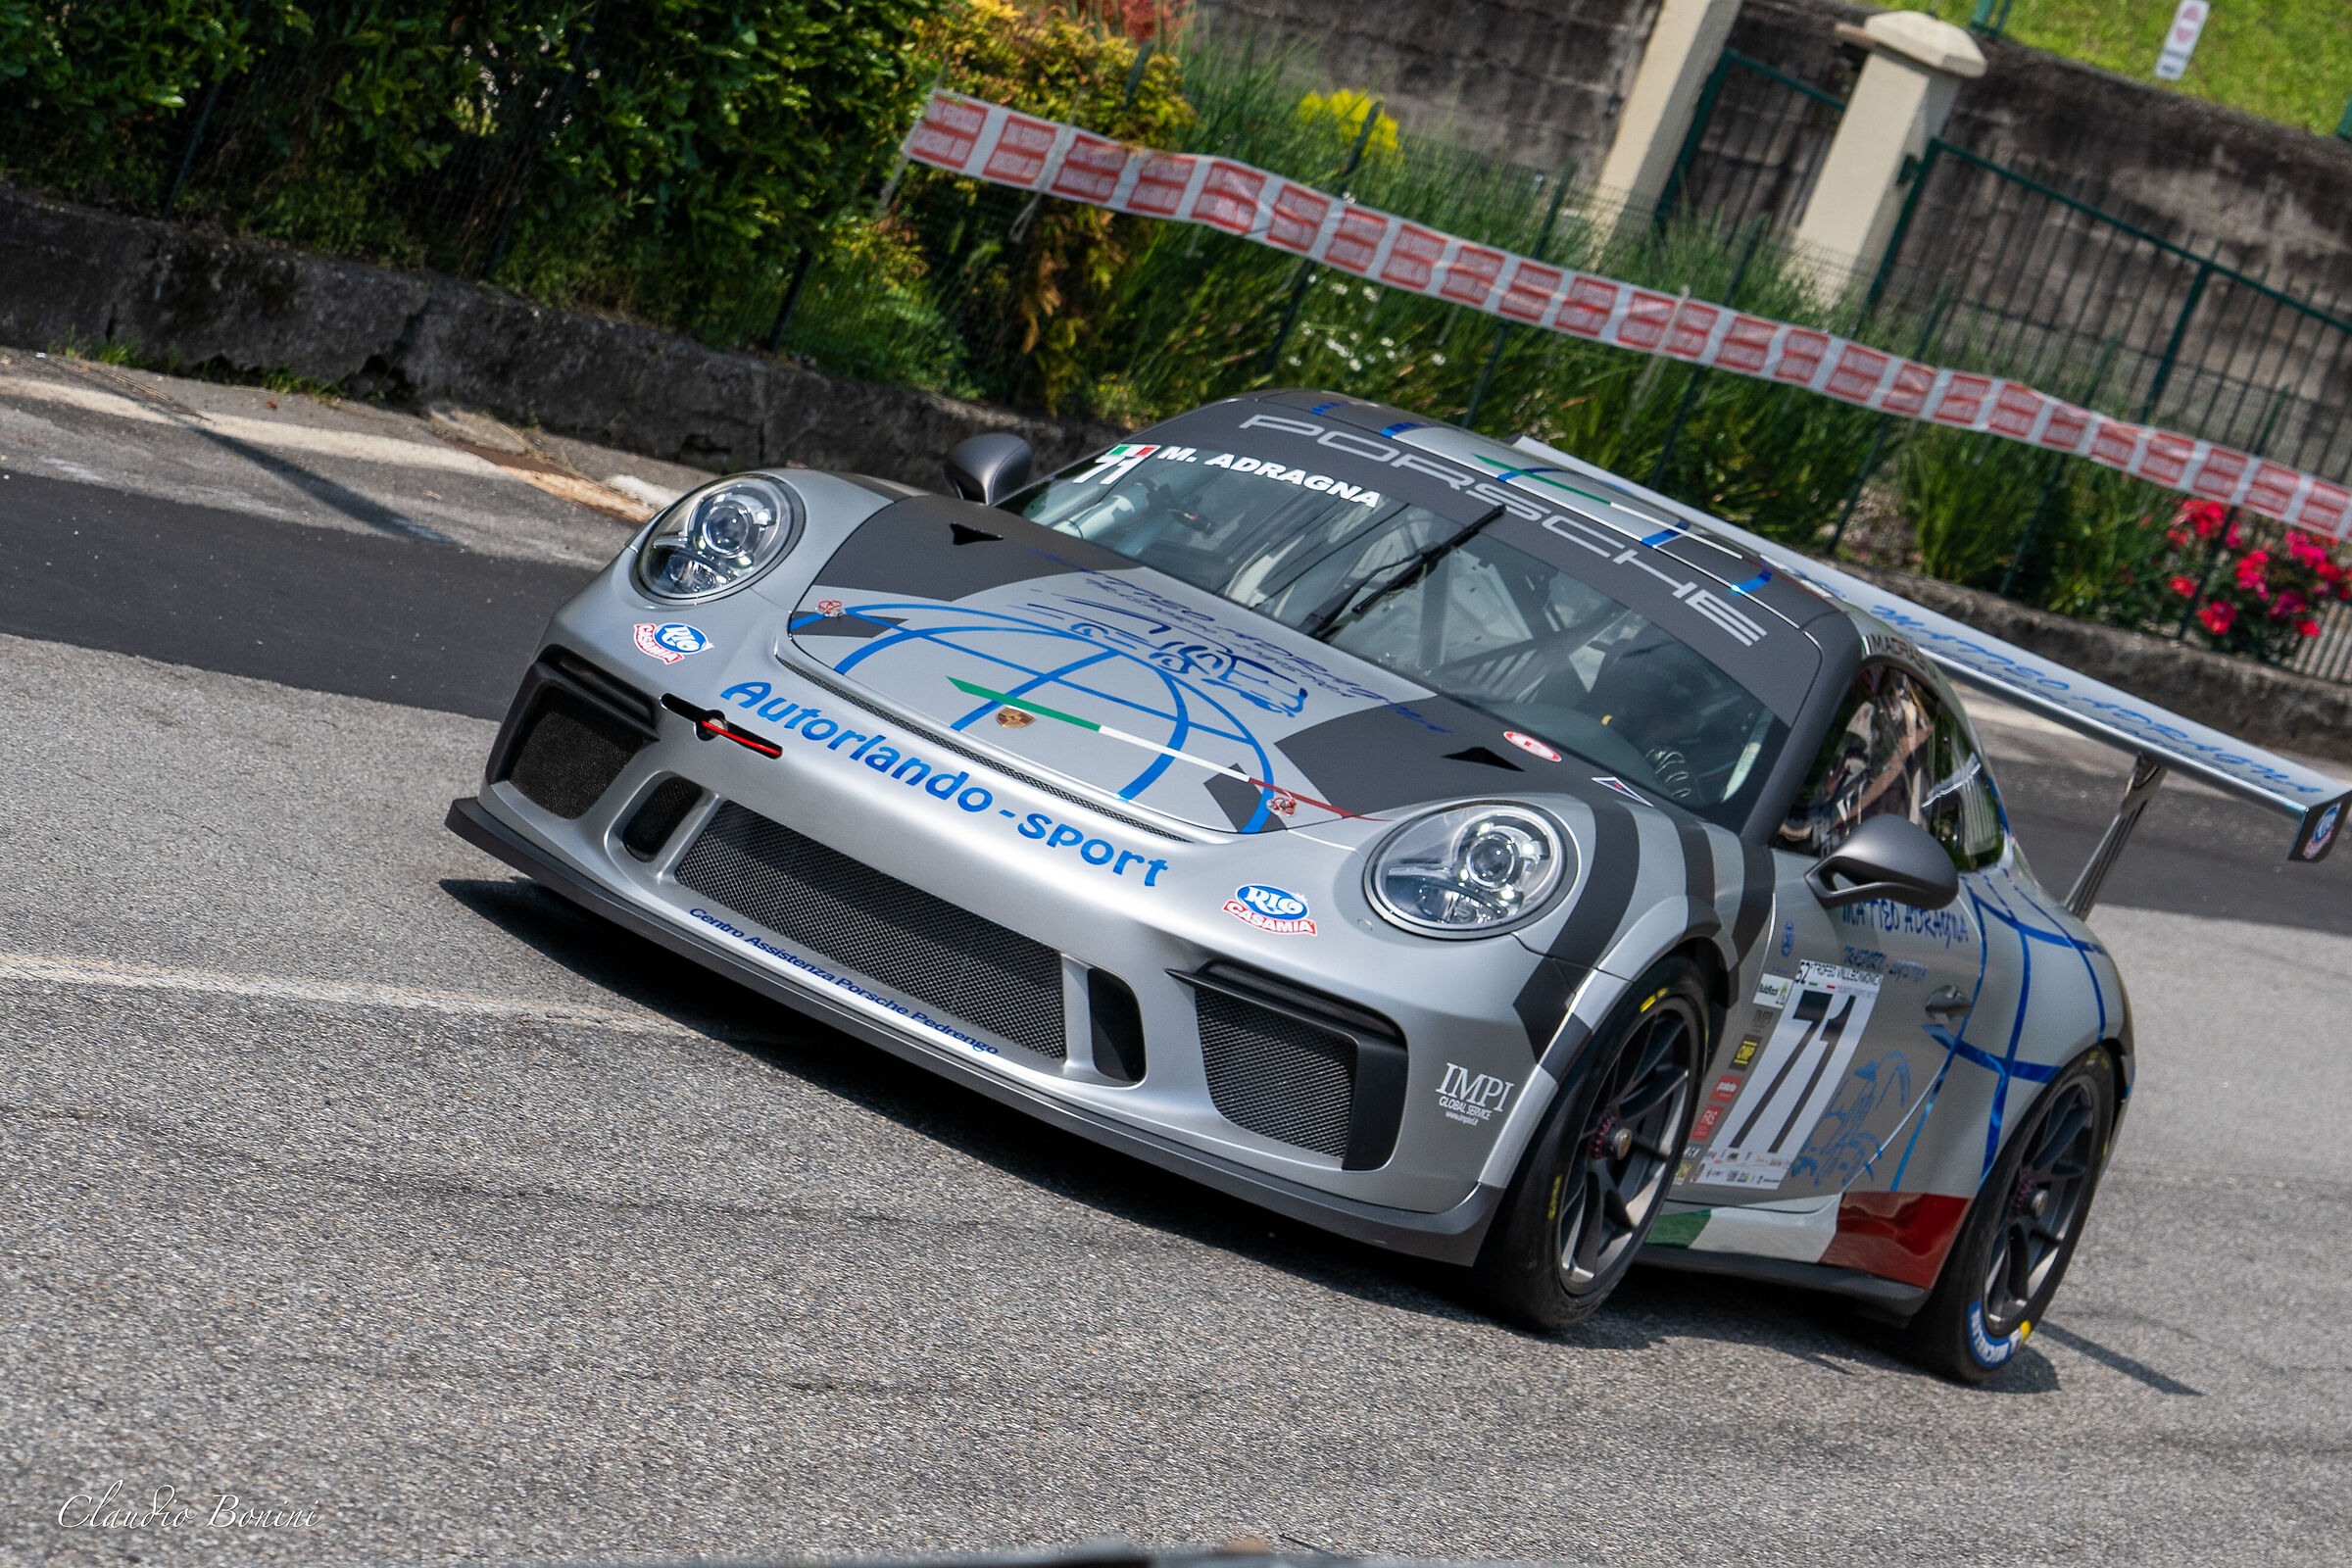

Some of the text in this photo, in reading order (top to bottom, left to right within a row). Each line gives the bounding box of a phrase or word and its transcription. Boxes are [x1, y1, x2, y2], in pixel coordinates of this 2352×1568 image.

[1073, 456, 1138, 485] 71
[1157, 446, 1383, 509] M. ADRAGNA
[1239, 413, 1768, 647] PORSCHE
[1226, 902, 1315, 933] CASAMIA
[1244, 886, 1304, 915] RIO
[689, 906, 1000, 1054] Centro Assistenza Porsche Pedrengo
[1435, 1061, 1515, 1113] IMPI
[1729, 989, 1856, 1154] 71
[1438, 1095, 1494, 1121] GLOBAL SERVICE
